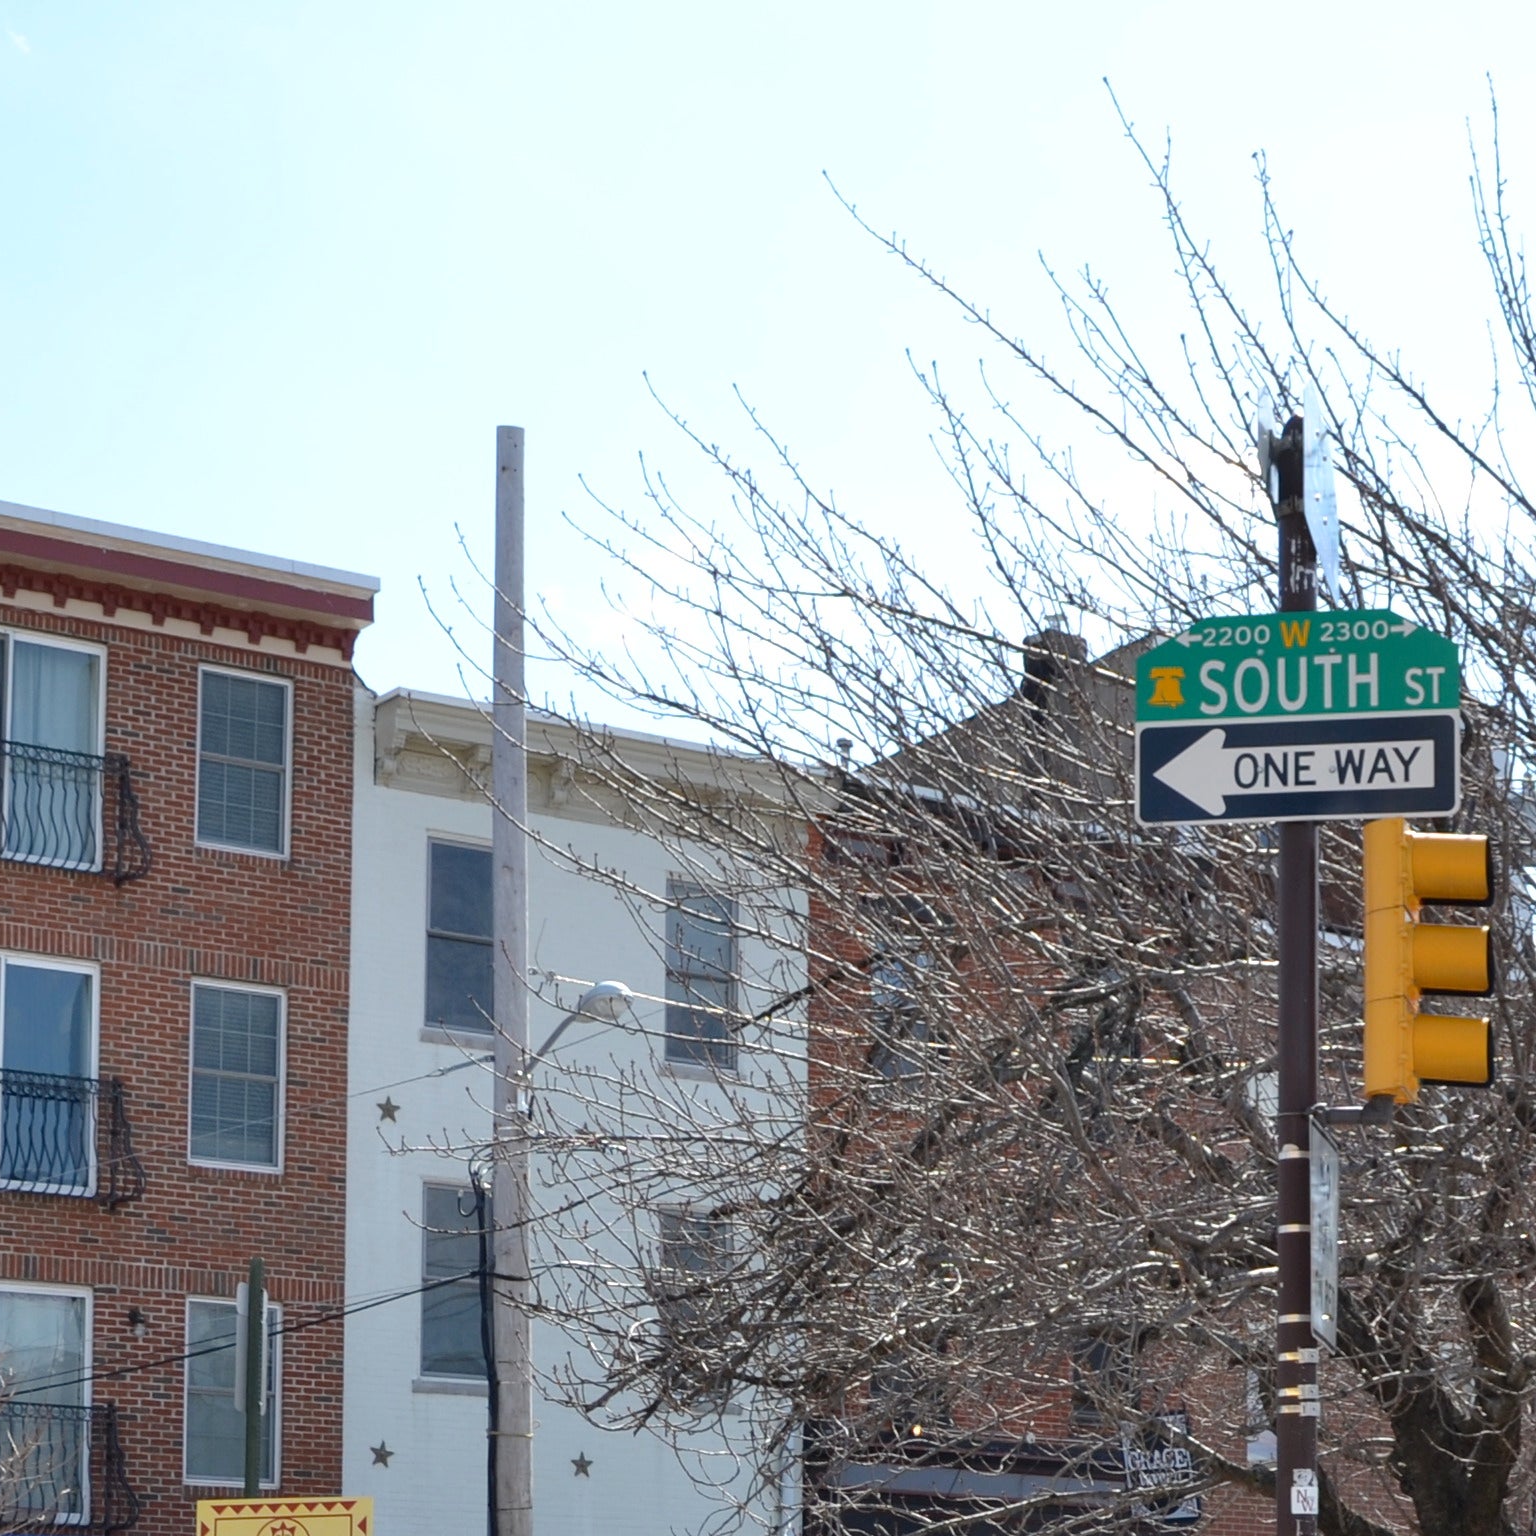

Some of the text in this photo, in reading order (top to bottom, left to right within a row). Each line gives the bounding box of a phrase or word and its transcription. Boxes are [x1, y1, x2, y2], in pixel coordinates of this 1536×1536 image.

[1202, 619, 1390, 648] 2200 W 2300
[1199, 652, 1446, 715] SOUTH ST
[1233, 747, 1421, 789] ONE WAY
